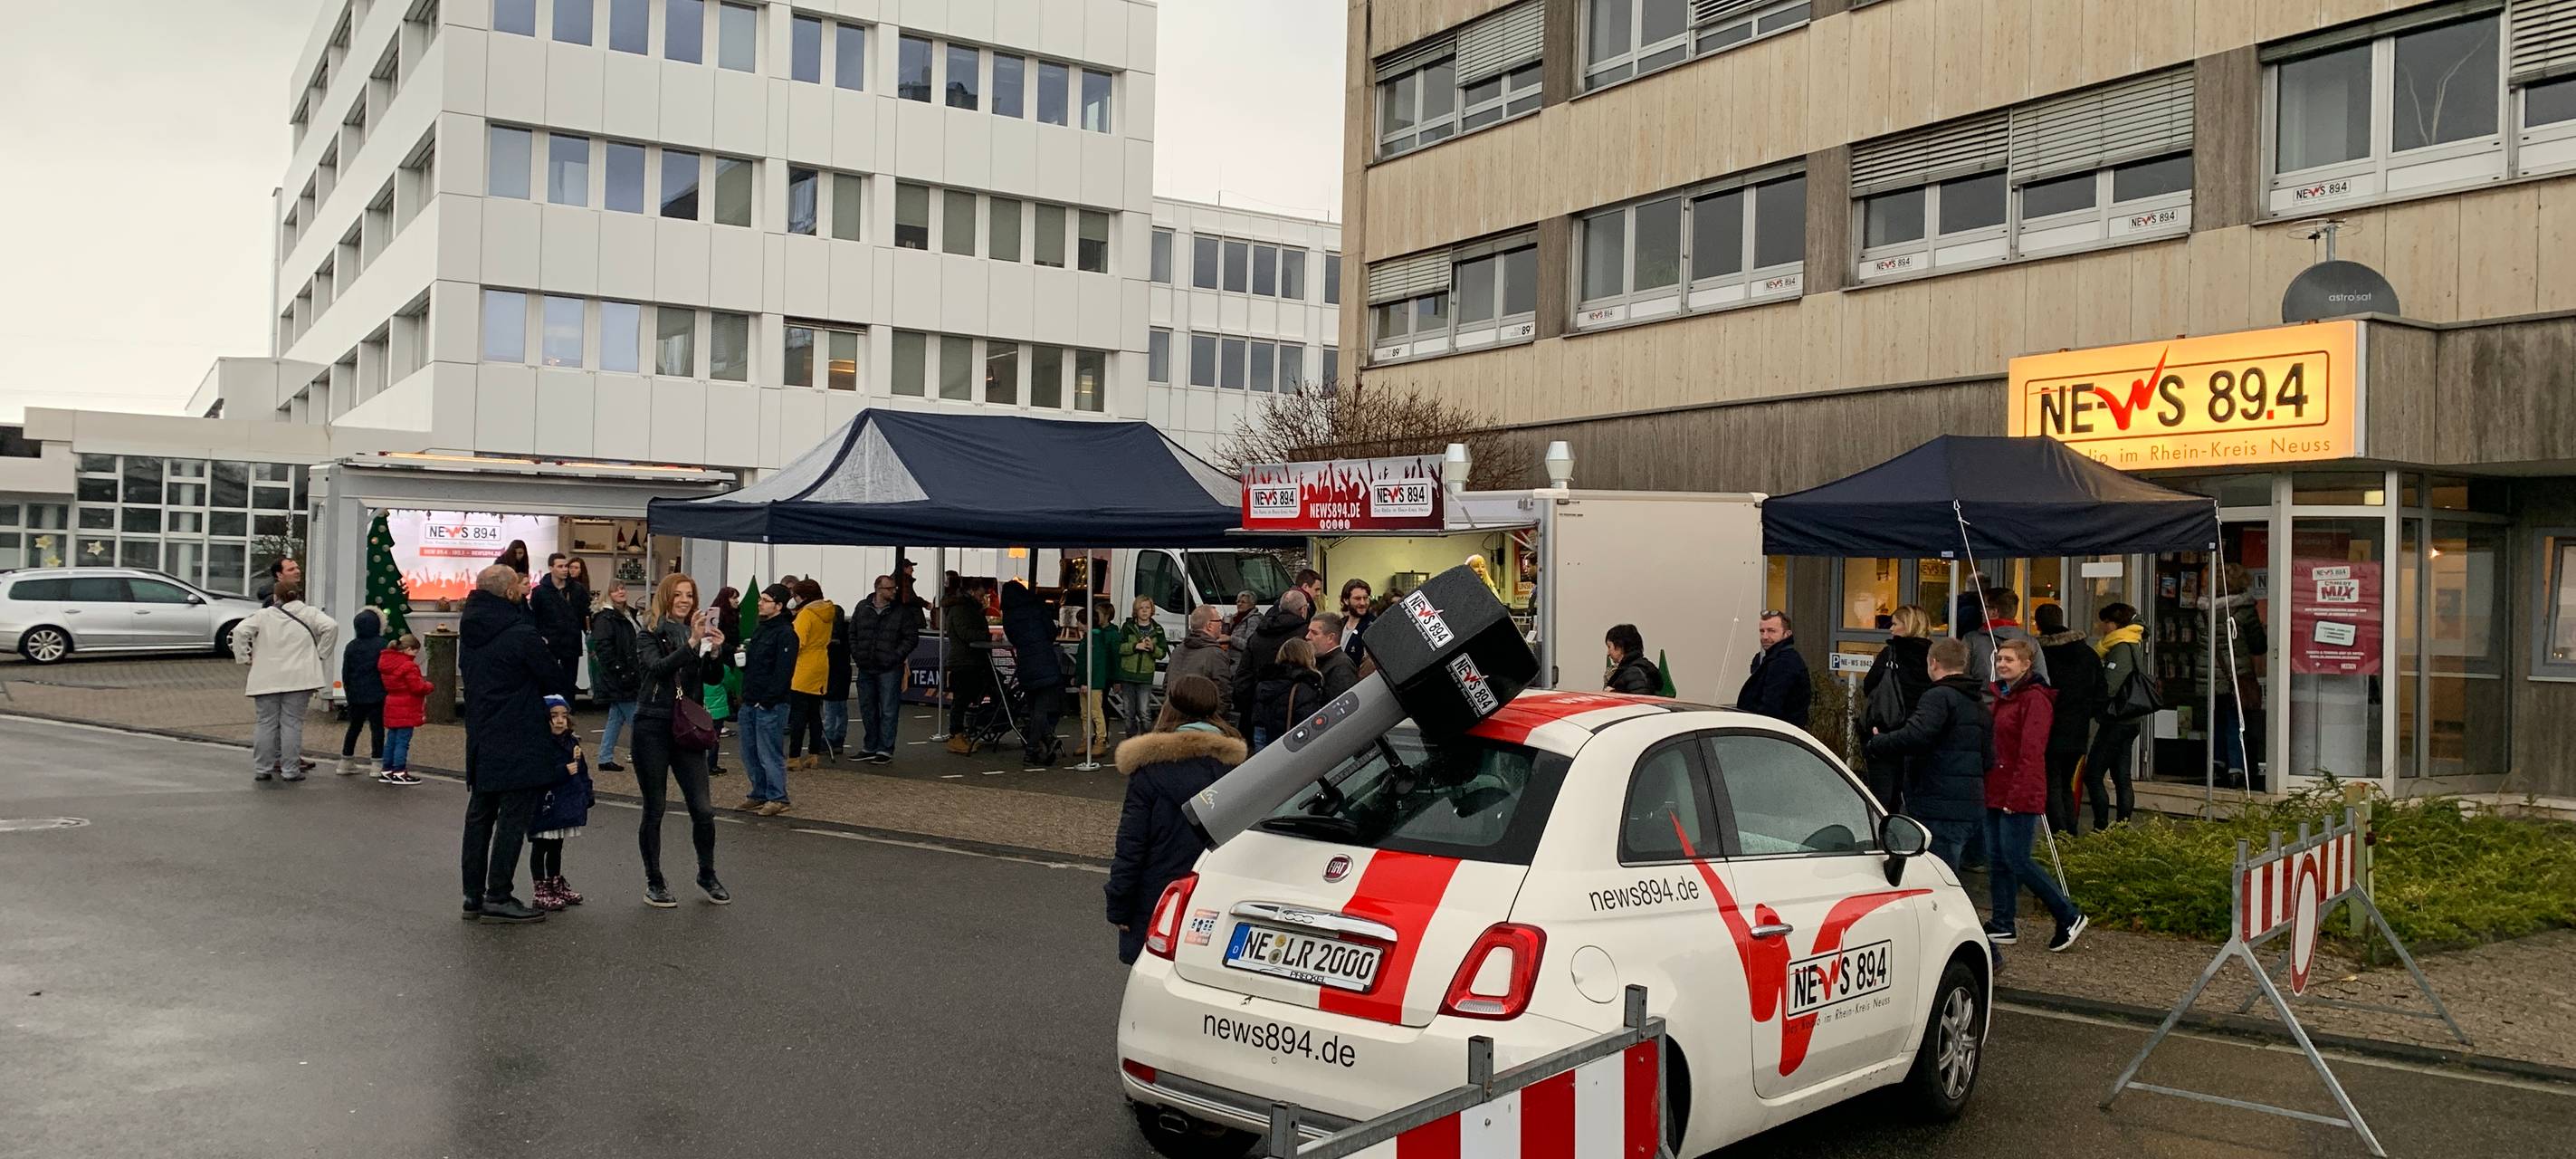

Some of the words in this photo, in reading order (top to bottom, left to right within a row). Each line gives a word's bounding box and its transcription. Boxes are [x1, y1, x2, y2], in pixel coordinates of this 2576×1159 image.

[2208, 362, 2309, 424] 89.4
[2120, 447, 2138, 463] im
[2150, 440, 2257, 463] Rhein-Kreis
[2271, 437, 2331, 455] Neuss
[1310, 501, 1360, 519] NEWS894.DE
[2321, 586, 2355, 599] MIX
[1328, 861, 1348, 875] FIAT
[1589, 875, 1700, 912] news894.de
[1232, 945, 1239, 954] D
[1241, 931, 1274, 961] NE
[1282, 937, 1315, 969] LR
[1313, 943, 1375, 980] 2000
[1856, 947, 1887, 991] 89.4
[1873, 996, 1892, 1010] Neuss
[1203, 1013, 1356, 1068] news894.de
